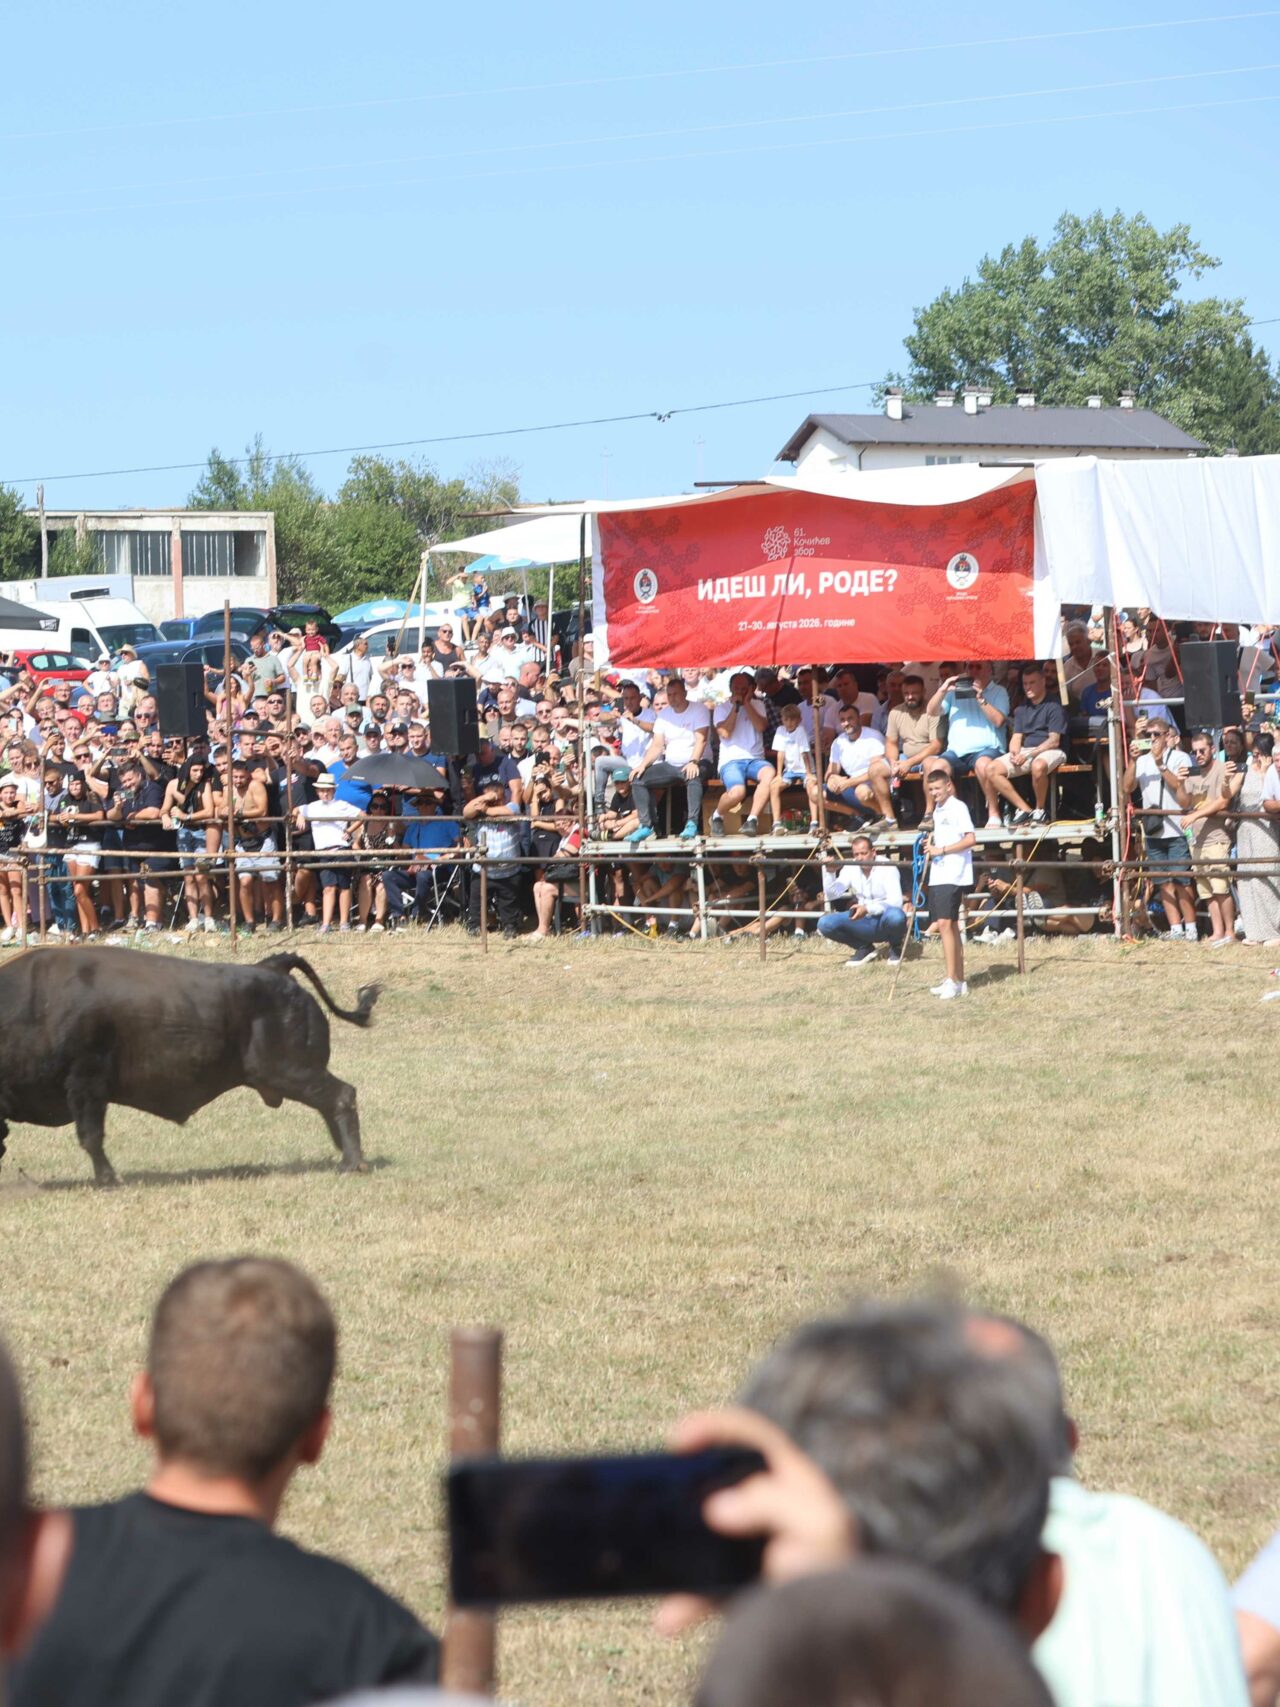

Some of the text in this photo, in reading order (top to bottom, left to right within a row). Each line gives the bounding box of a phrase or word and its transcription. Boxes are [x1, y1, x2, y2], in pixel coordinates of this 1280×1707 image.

[793, 547, 815, 557] збор
[697, 568, 898, 604] ИДЕШ ЛИ, РОДЕ?
